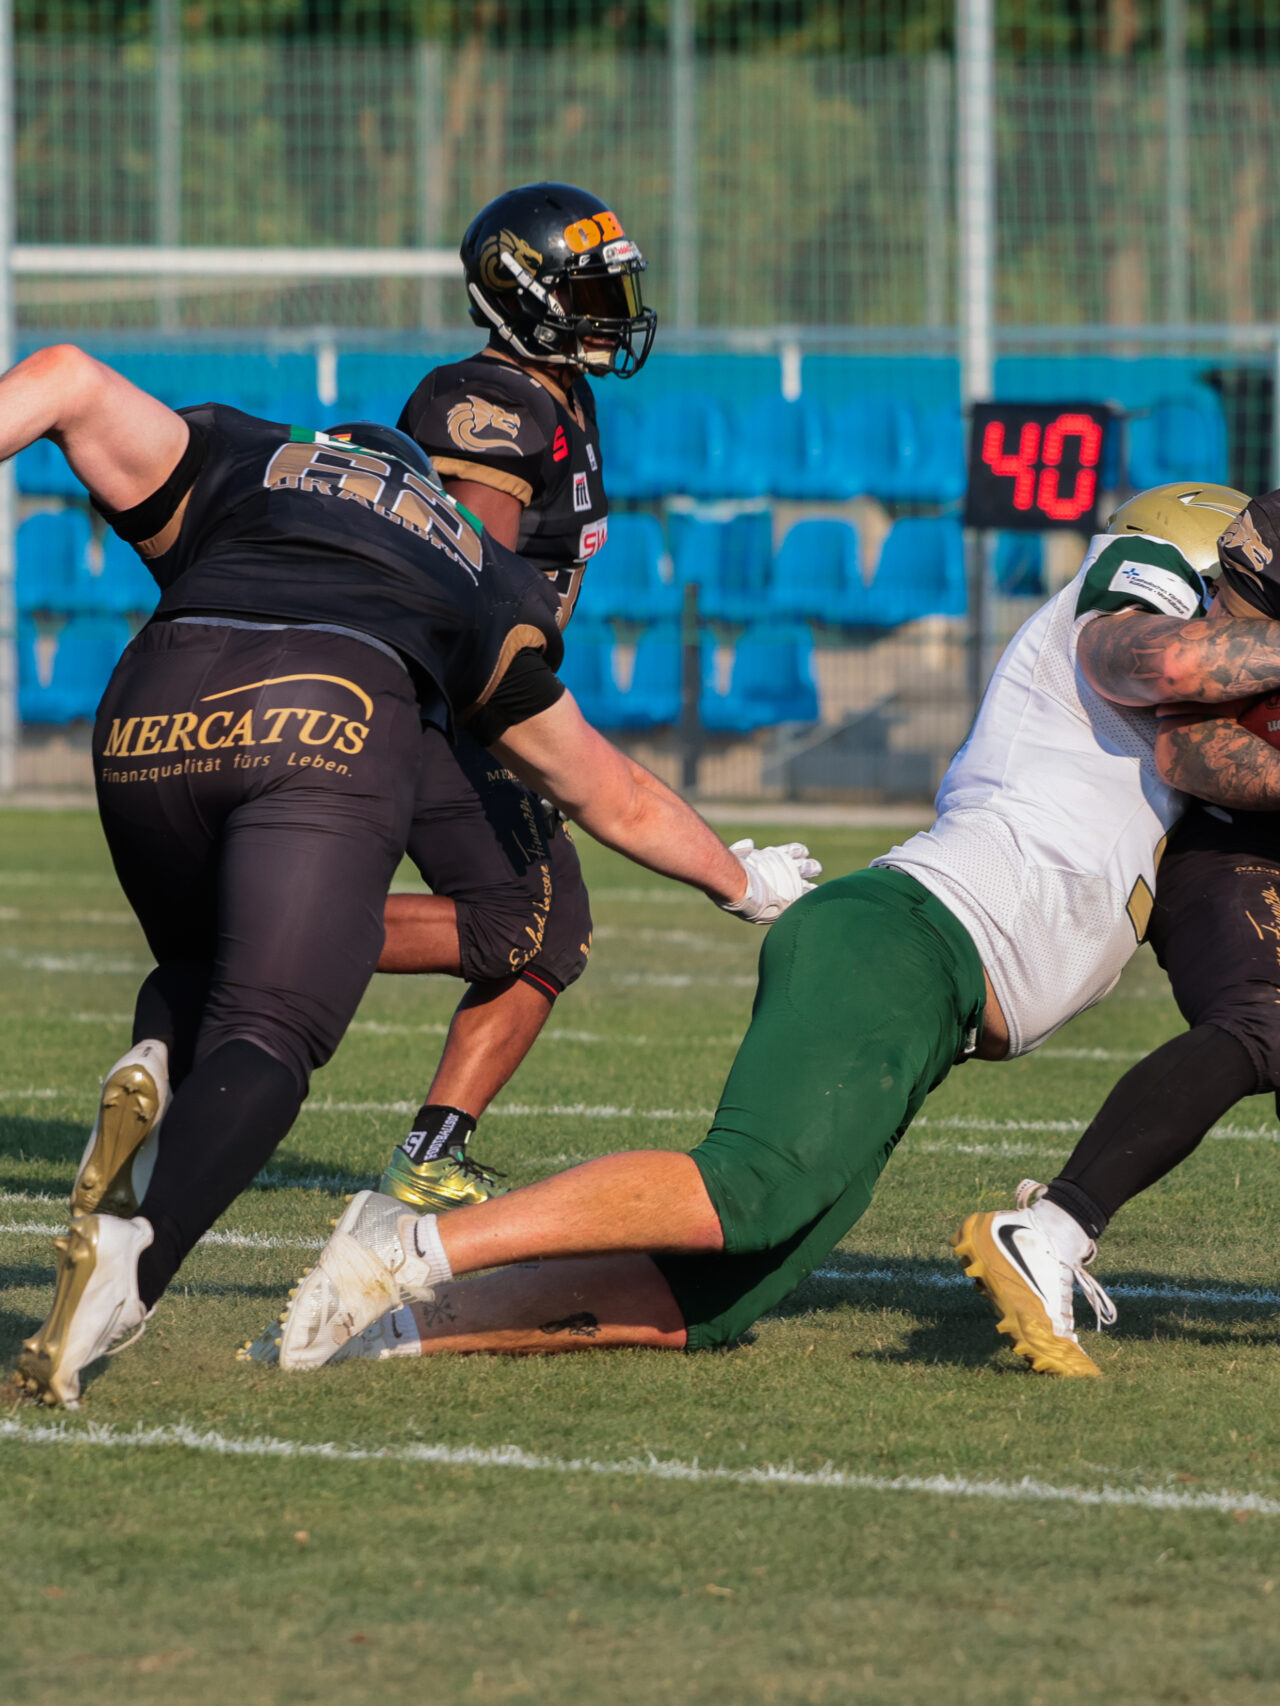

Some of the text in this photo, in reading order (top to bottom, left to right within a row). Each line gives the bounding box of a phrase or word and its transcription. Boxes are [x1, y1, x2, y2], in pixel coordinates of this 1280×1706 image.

[563, 211, 625, 253] OB
[982, 413, 1103, 521] 40
[262, 441, 485, 573] 62
[102, 707, 370, 756] MERCATUS
[102, 752, 353, 784] Finanzqualität fürs Leben.
